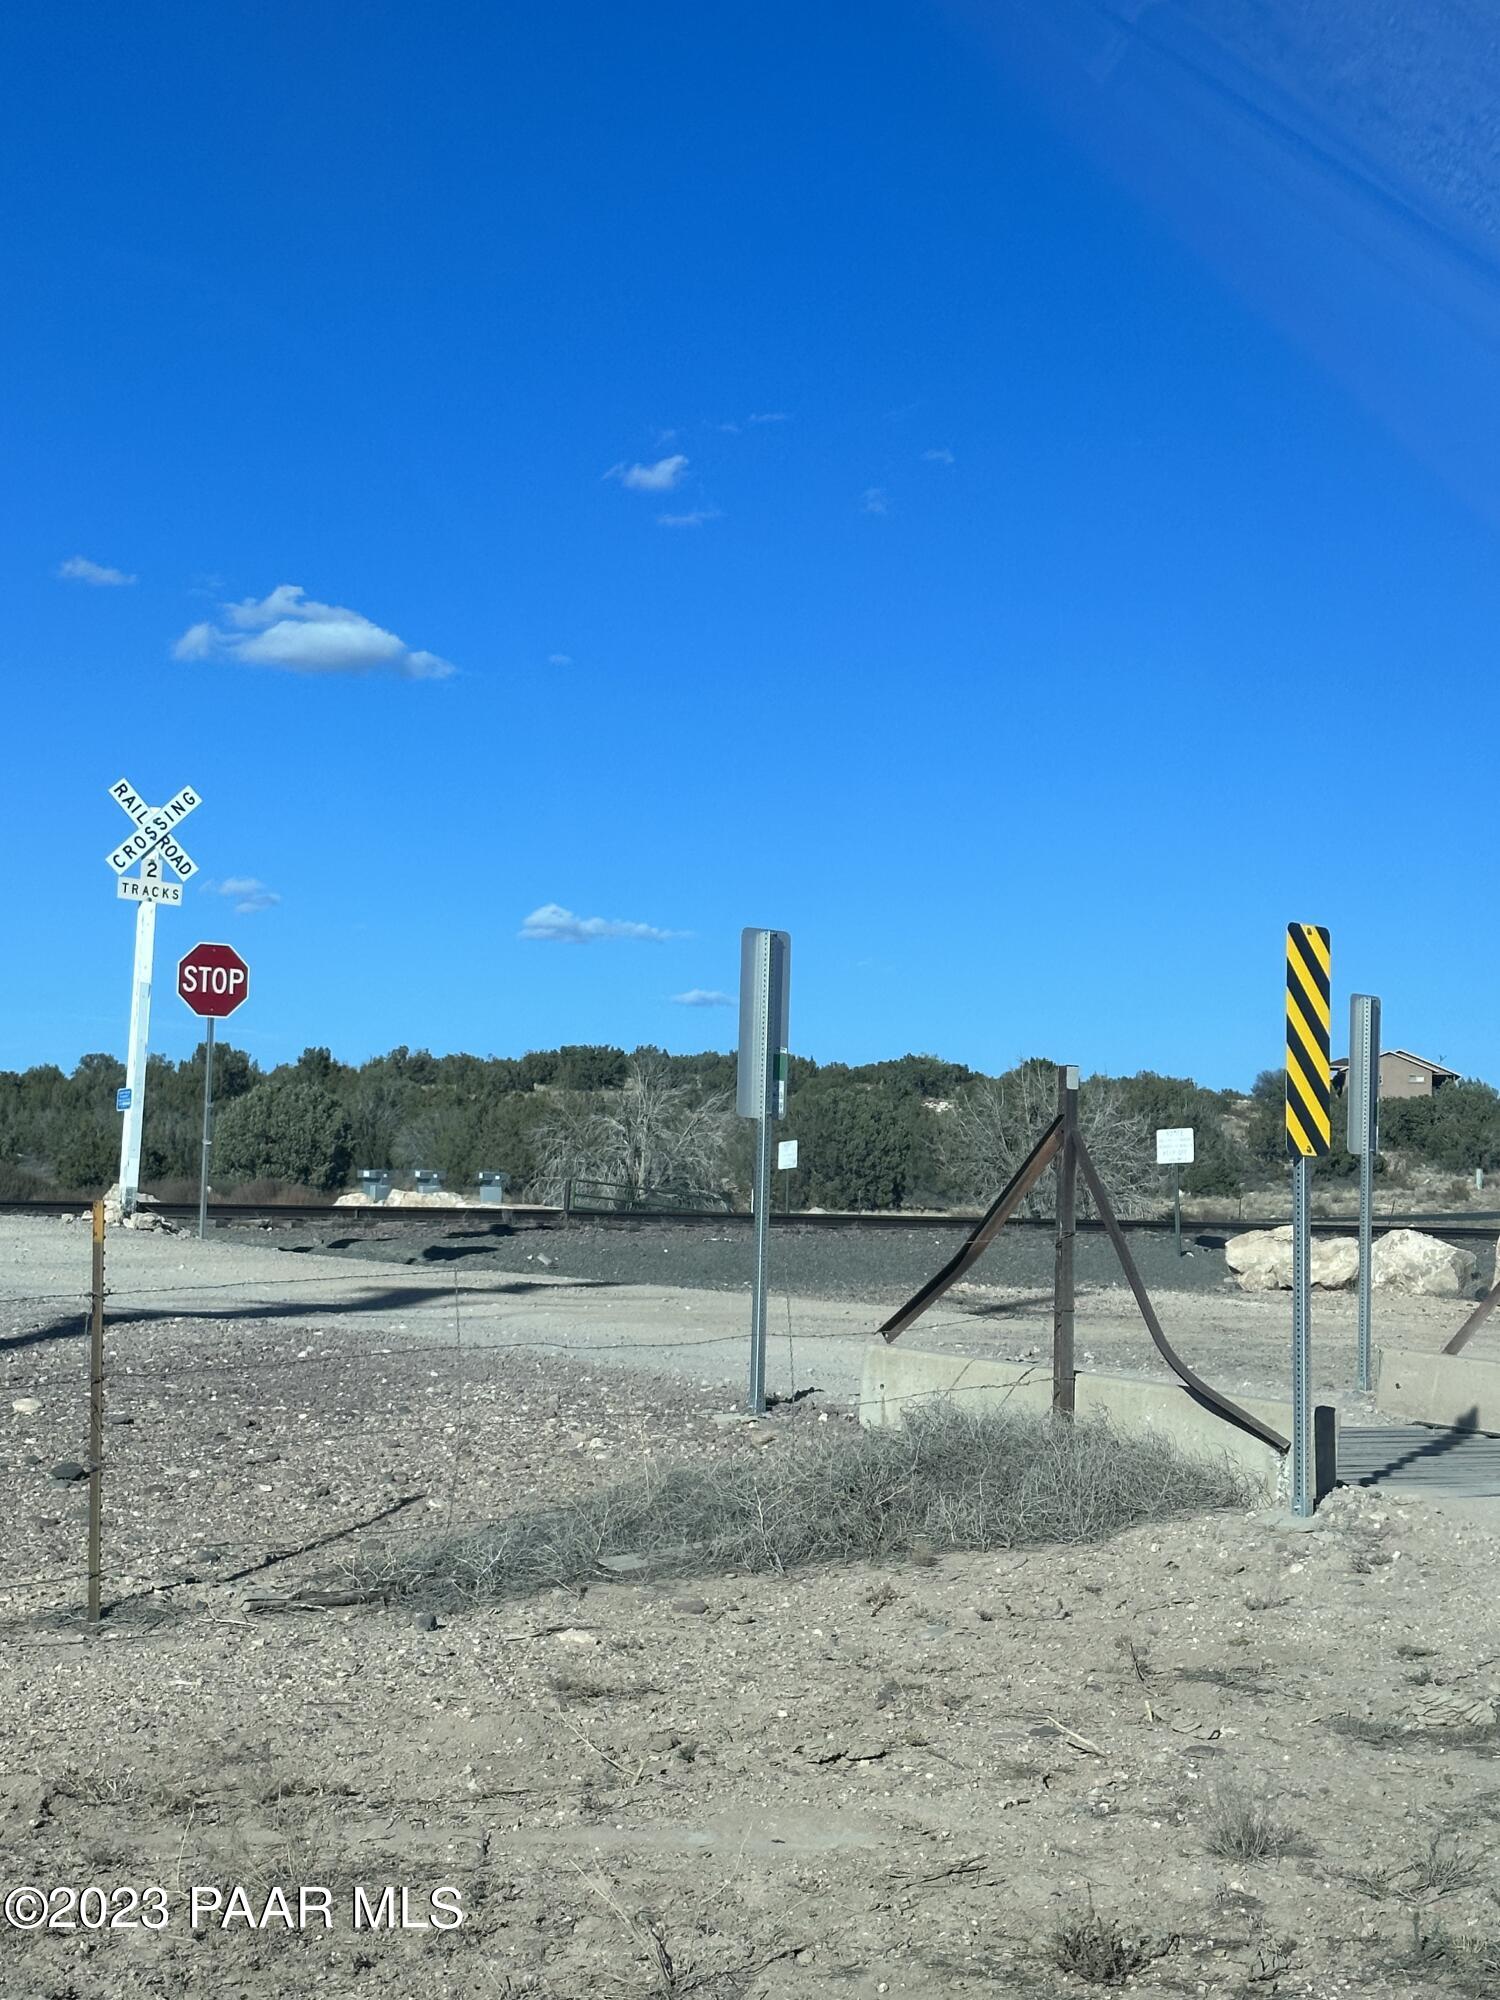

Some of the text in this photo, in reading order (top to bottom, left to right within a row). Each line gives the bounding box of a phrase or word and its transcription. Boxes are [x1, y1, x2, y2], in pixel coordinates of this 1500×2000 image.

[112, 791, 196, 869] CROSSING
[147, 862, 158, 878] 2
[122, 882, 179, 900] TRACKS
[182, 965, 244, 995] STOP
